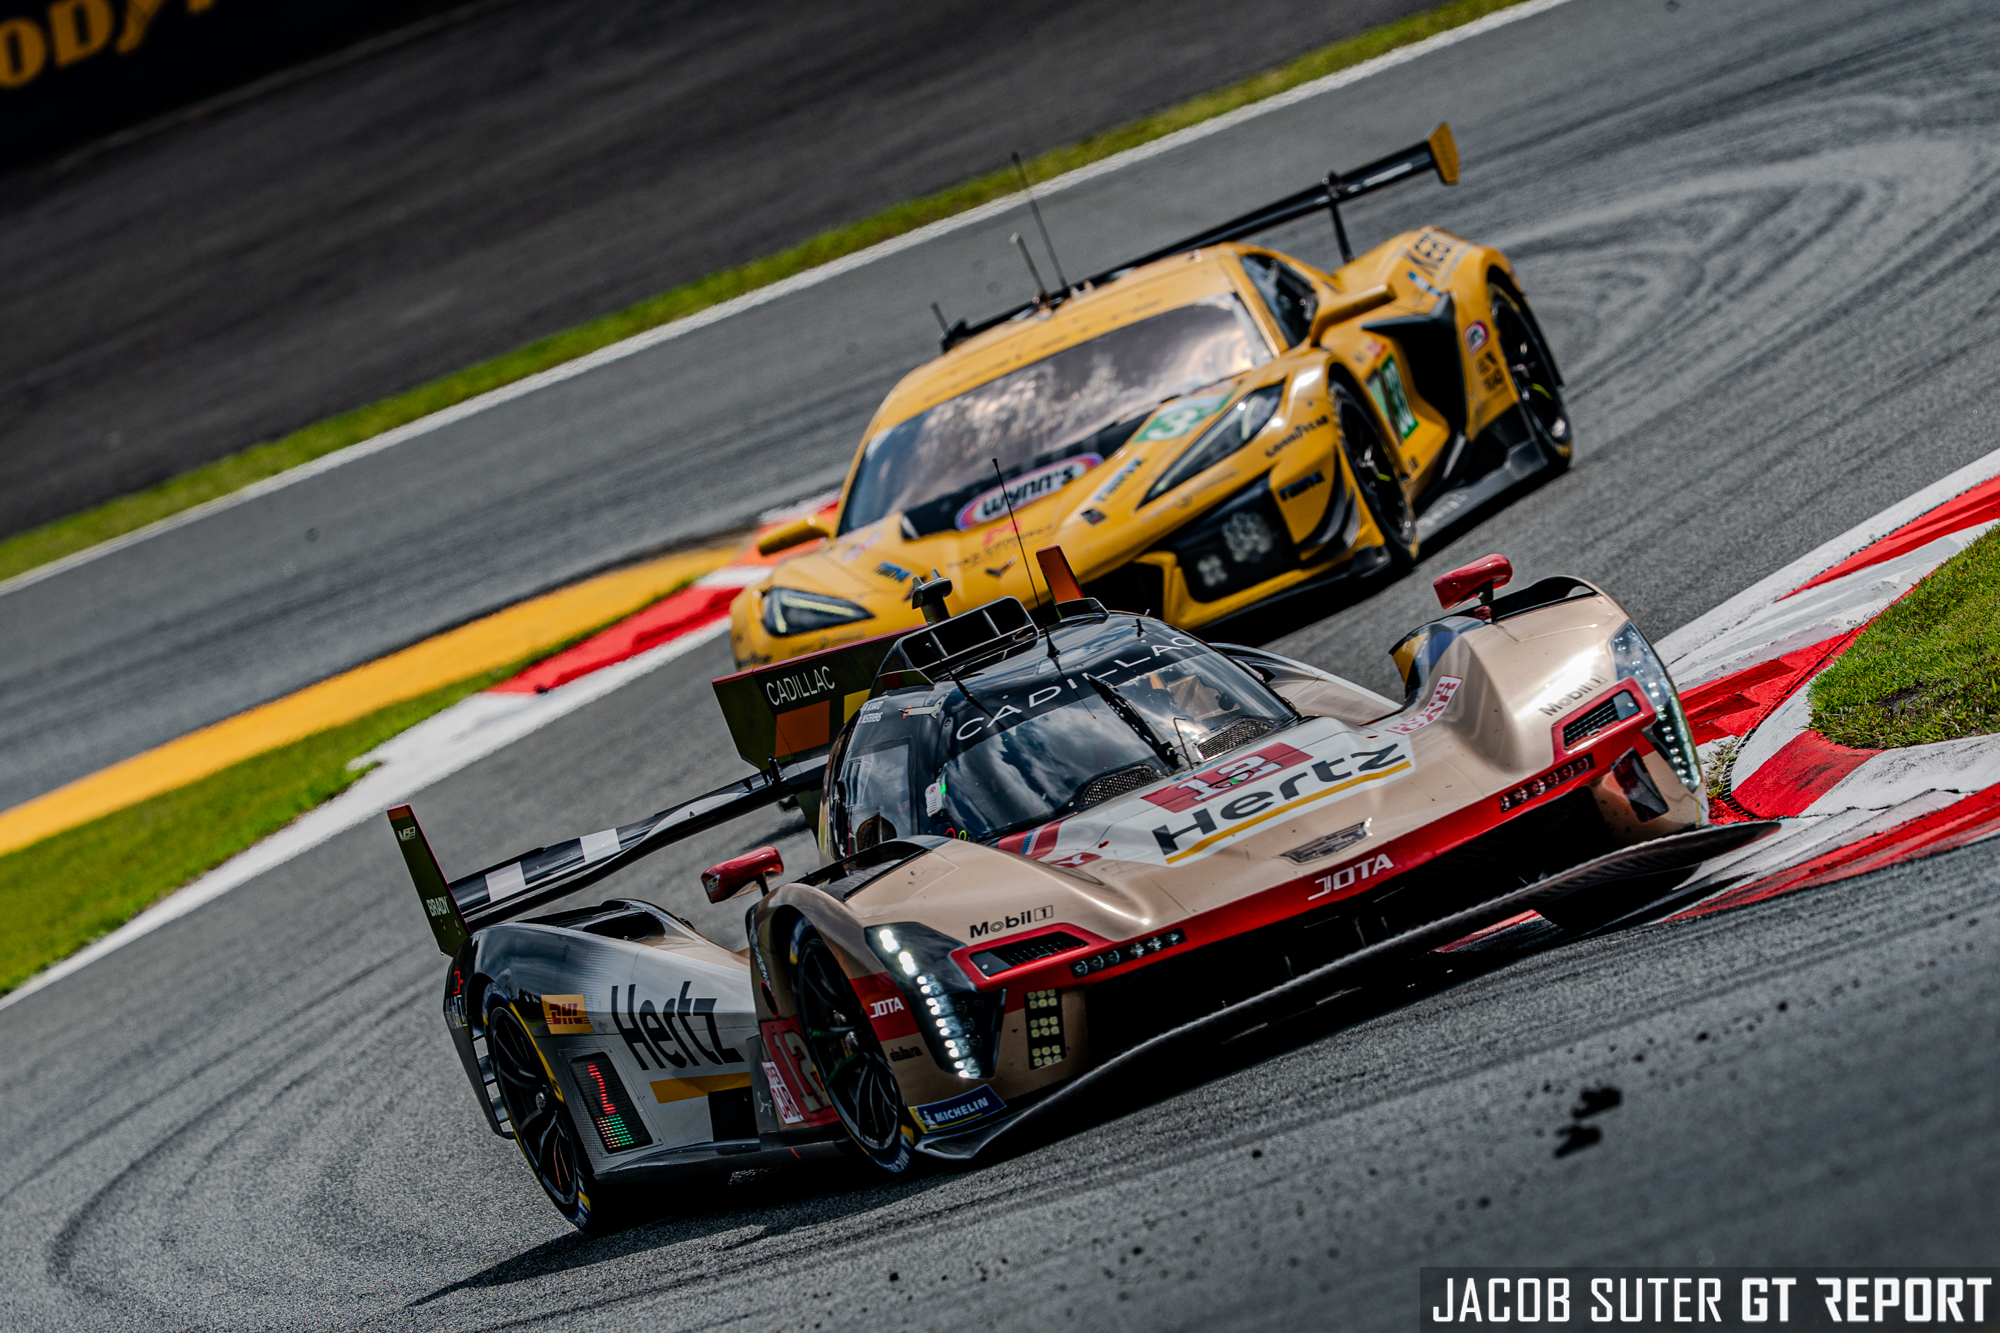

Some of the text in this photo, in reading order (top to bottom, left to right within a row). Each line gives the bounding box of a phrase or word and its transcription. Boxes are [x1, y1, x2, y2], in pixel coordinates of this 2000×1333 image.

[766, 666, 836, 706] CADILLAC
[956, 637, 1197, 741] CADILLAC
[1539, 681, 1592, 717] Mobil
[1400, 681, 1457, 733] CAR
[1174, 754, 1285, 803] 12
[1151, 743, 1406, 856] Hertz
[1308, 853, 1394, 900] JOTA
[426, 896, 450, 917] BRADY
[969, 910, 1031, 939] Mobil
[549, 1003, 584, 1025] DHL
[611, 981, 746, 1071] Hertz
[870, 997, 904, 1018] JOTA
[933, 1097, 989, 1123] MICHELIN
